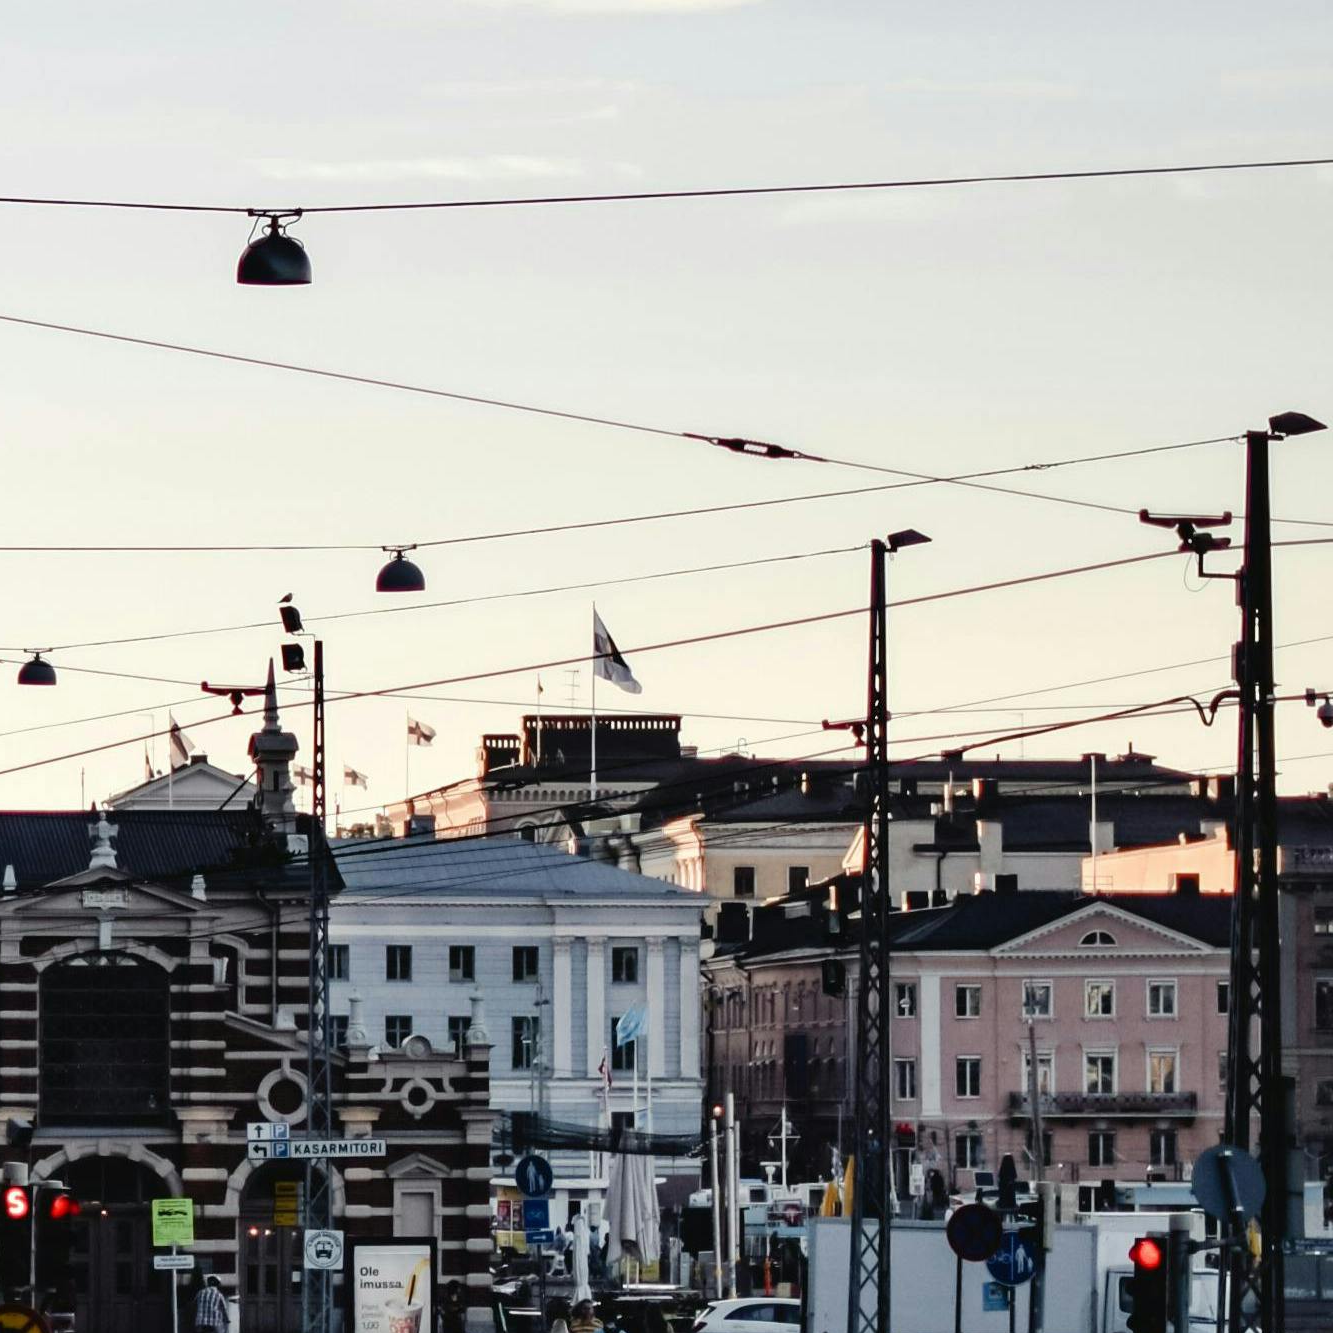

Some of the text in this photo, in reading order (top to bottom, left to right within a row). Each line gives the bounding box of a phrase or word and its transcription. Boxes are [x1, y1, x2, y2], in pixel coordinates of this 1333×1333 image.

[294, 1143, 382, 1155] KASARMITORI
[359, 1267, 380, 1277] Ole
[359, 1279, 405, 1289] imussa.
